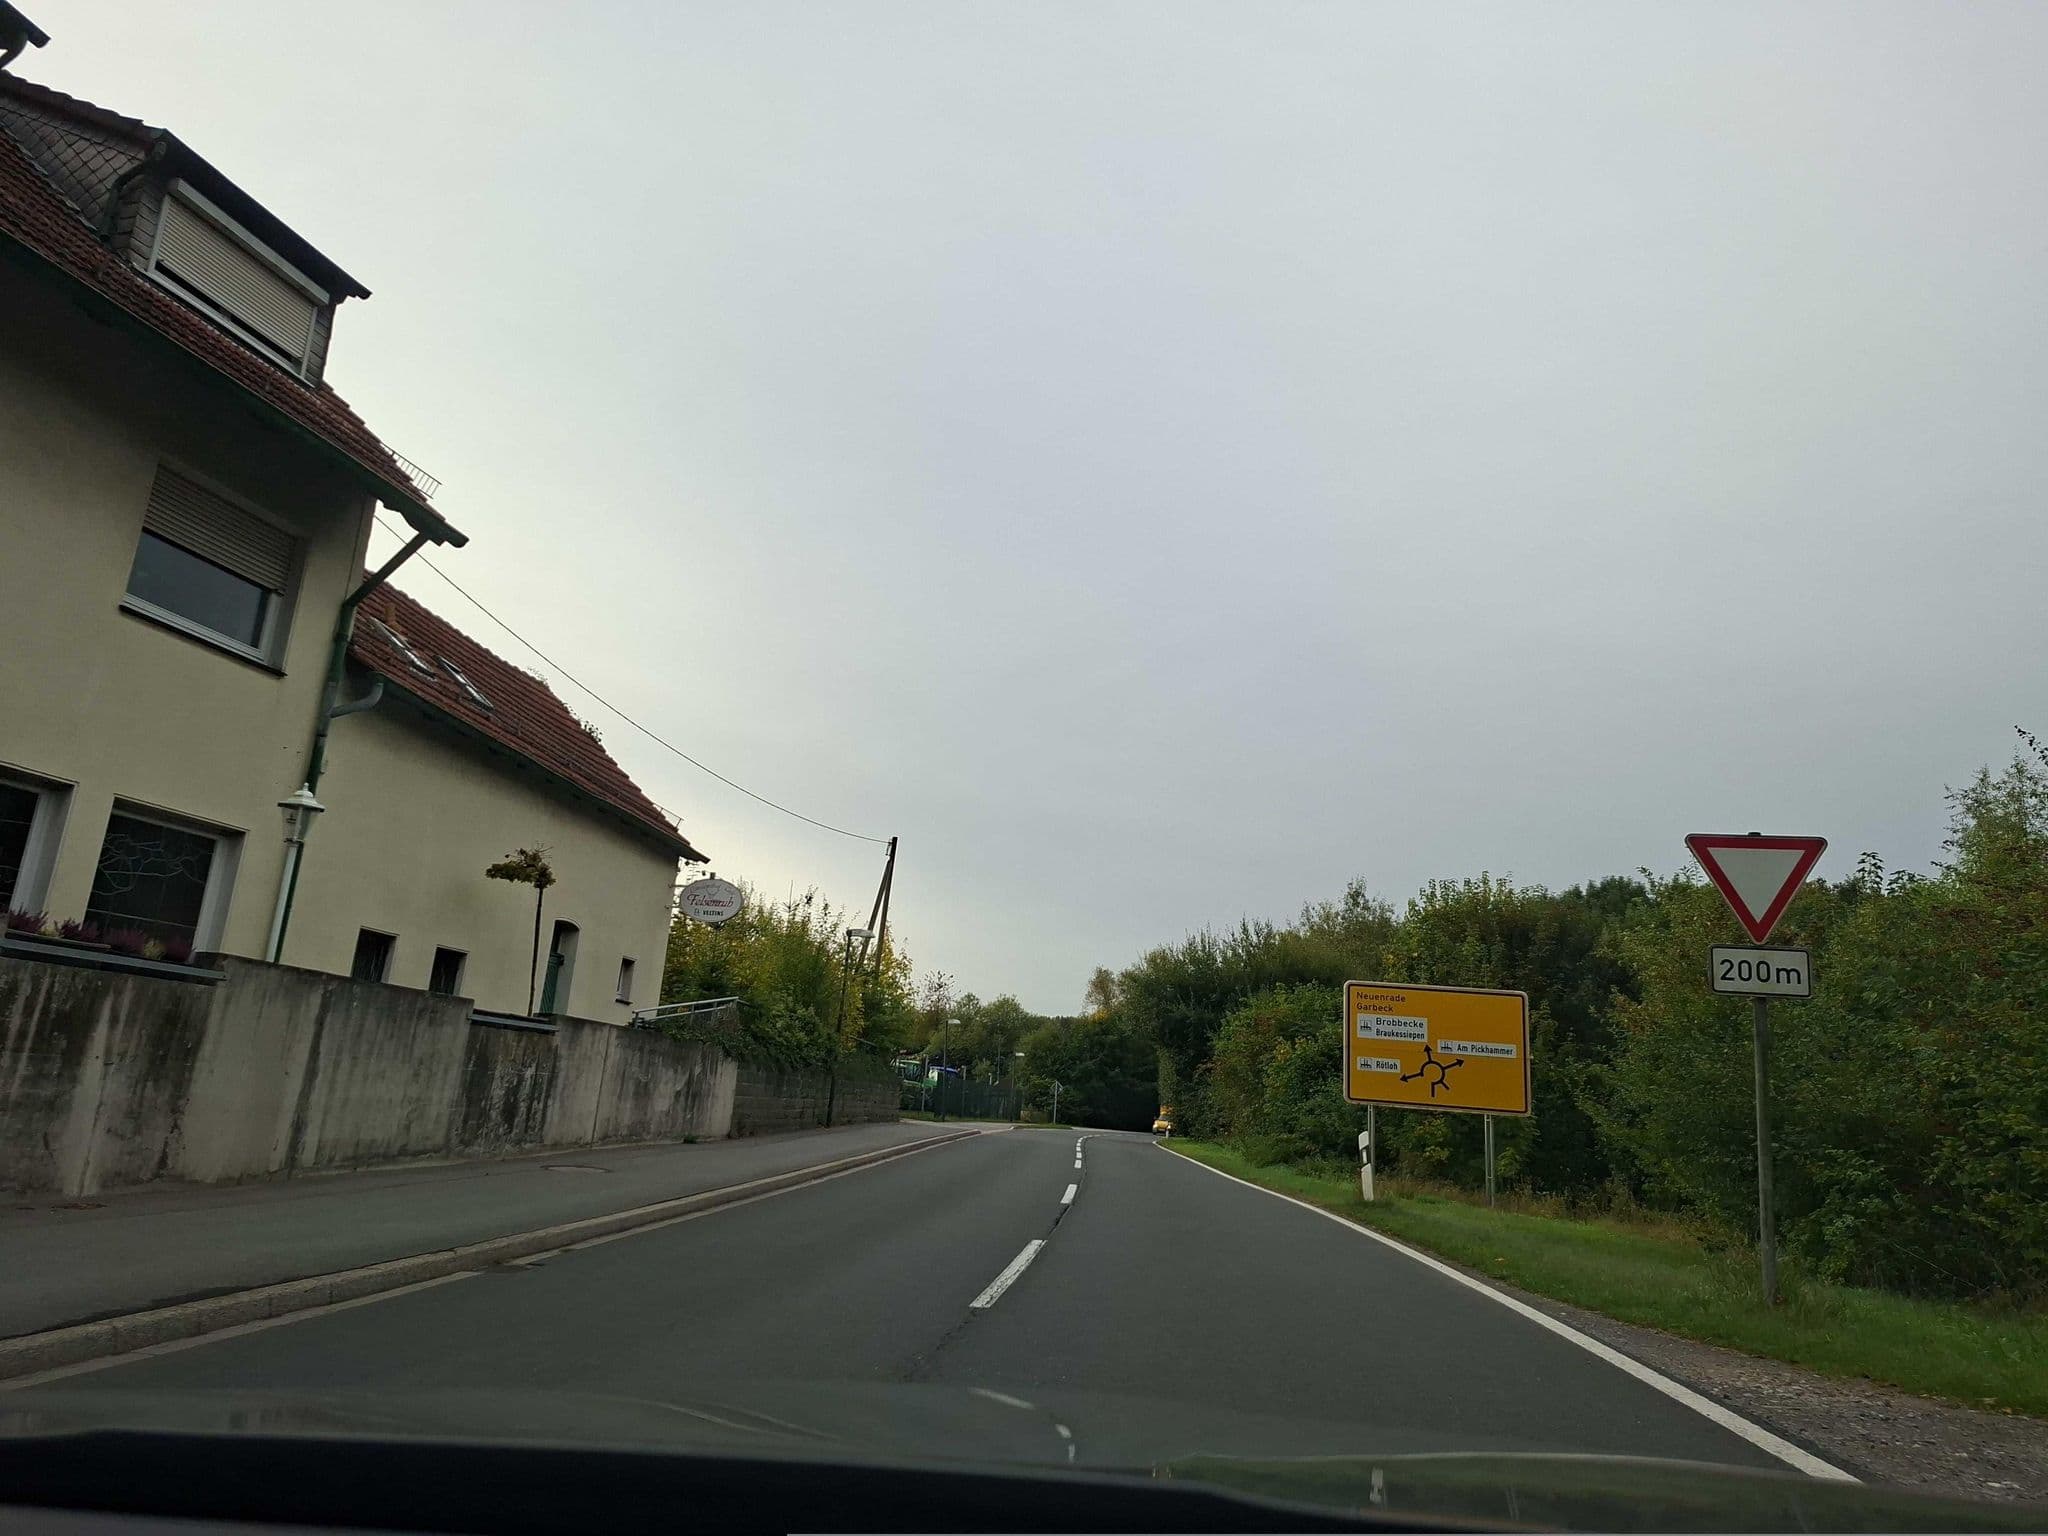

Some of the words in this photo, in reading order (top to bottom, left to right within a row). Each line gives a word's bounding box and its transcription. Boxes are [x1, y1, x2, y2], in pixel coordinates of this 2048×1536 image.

[1356, 991, 1406, 1002] Neuenrade
[1356, 1002, 1394, 1013] Garbeck
[1375, 1017, 1424, 1029] Brobbecke
[1375, 1028, 1425, 1041] Braukessiepen
[1456, 1043, 1469, 1052] Am
[1470, 1044, 1514, 1055] Pickhammer
